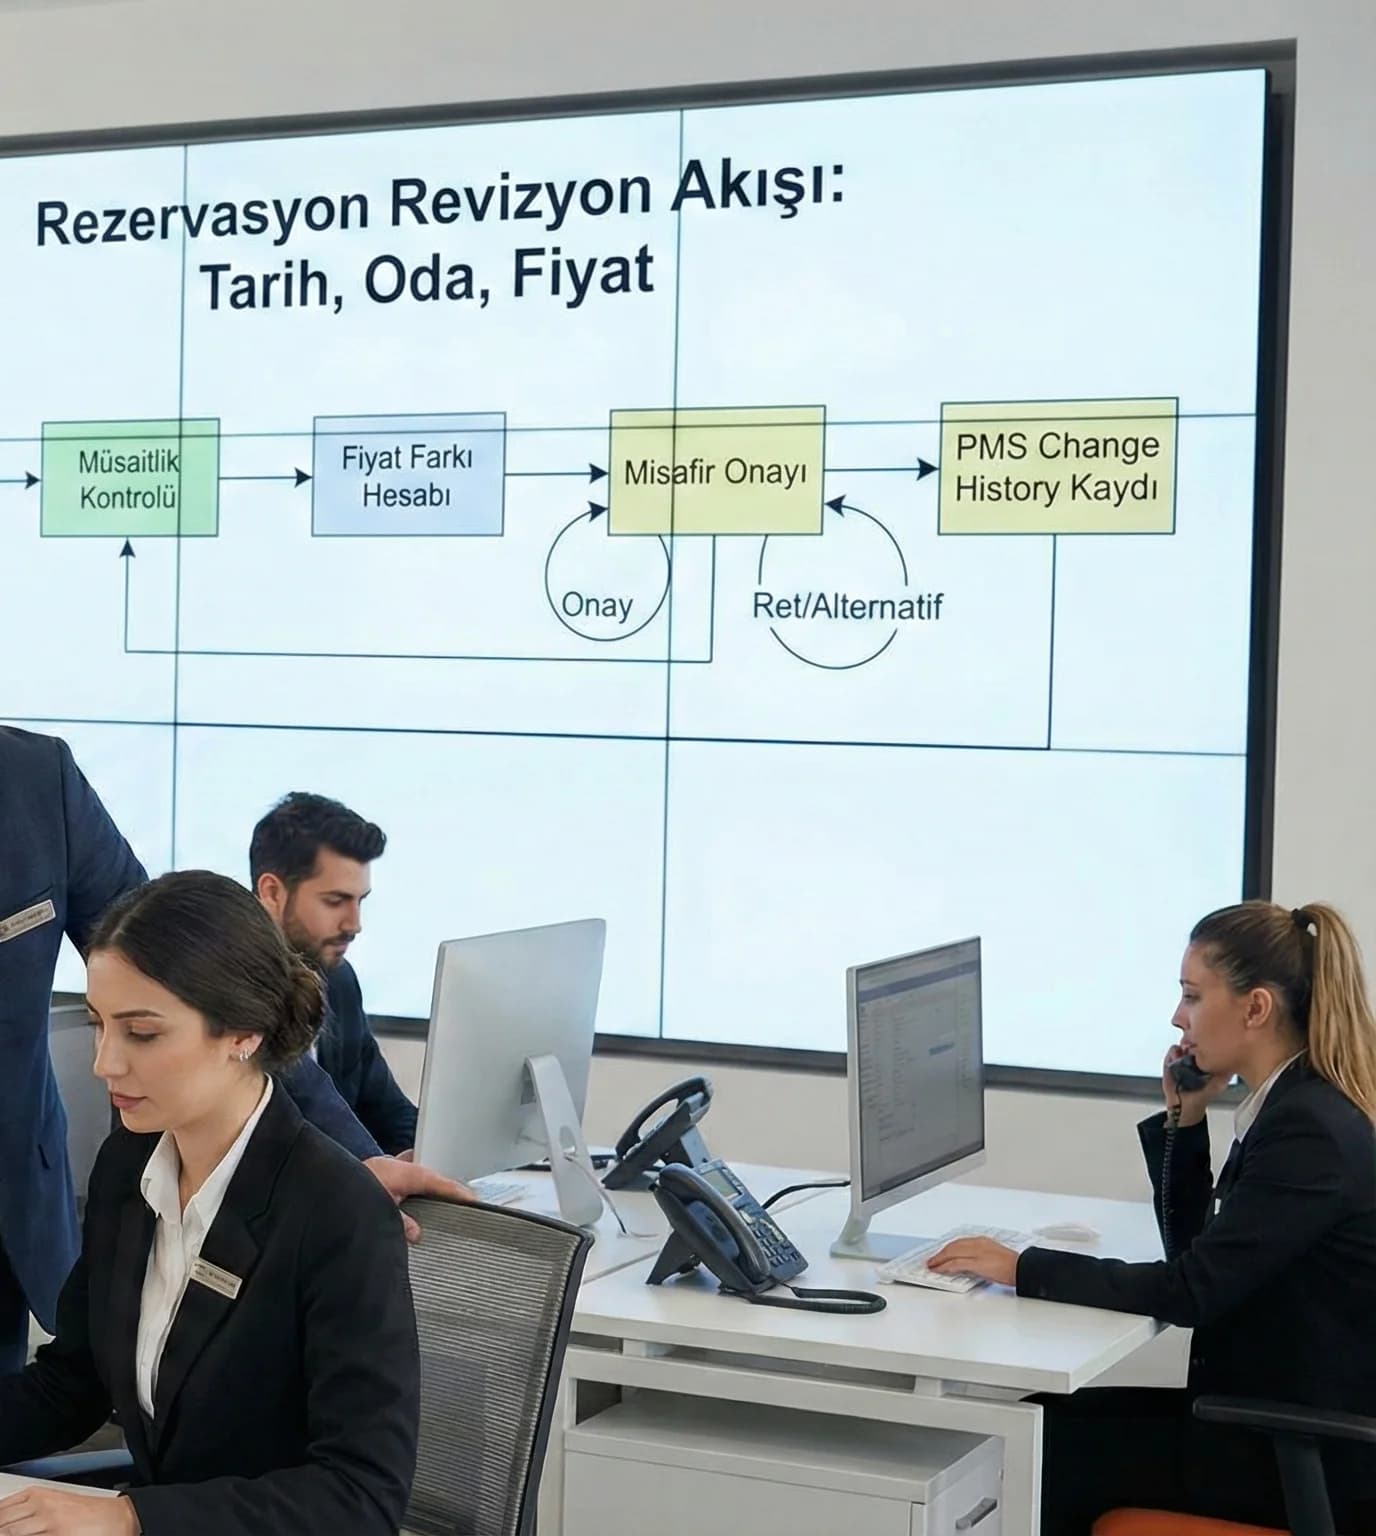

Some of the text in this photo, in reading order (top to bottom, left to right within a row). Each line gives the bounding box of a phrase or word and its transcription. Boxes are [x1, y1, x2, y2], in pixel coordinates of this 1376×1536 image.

[38, 158, 844, 246] Rezervasyon Revizyon Akışı:
[200, 244, 654, 314] Tarih, Oda, Fiyat
[79, 449, 179, 474] Müsaitlik
[343, 444, 471, 476] Fiyat Farkı
[958, 432, 1159, 465] PMS Change
[625, 458, 805, 489] Misafir Onayı
[82, 484, 176, 510] Kontrolü
[364, 483, 449, 507] Hesabı
[957, 473, 1156, 507] History Kaydı
[562, 592, 633, 624] Onay
[753, 591, 943, 622] Ret/Alternatif
